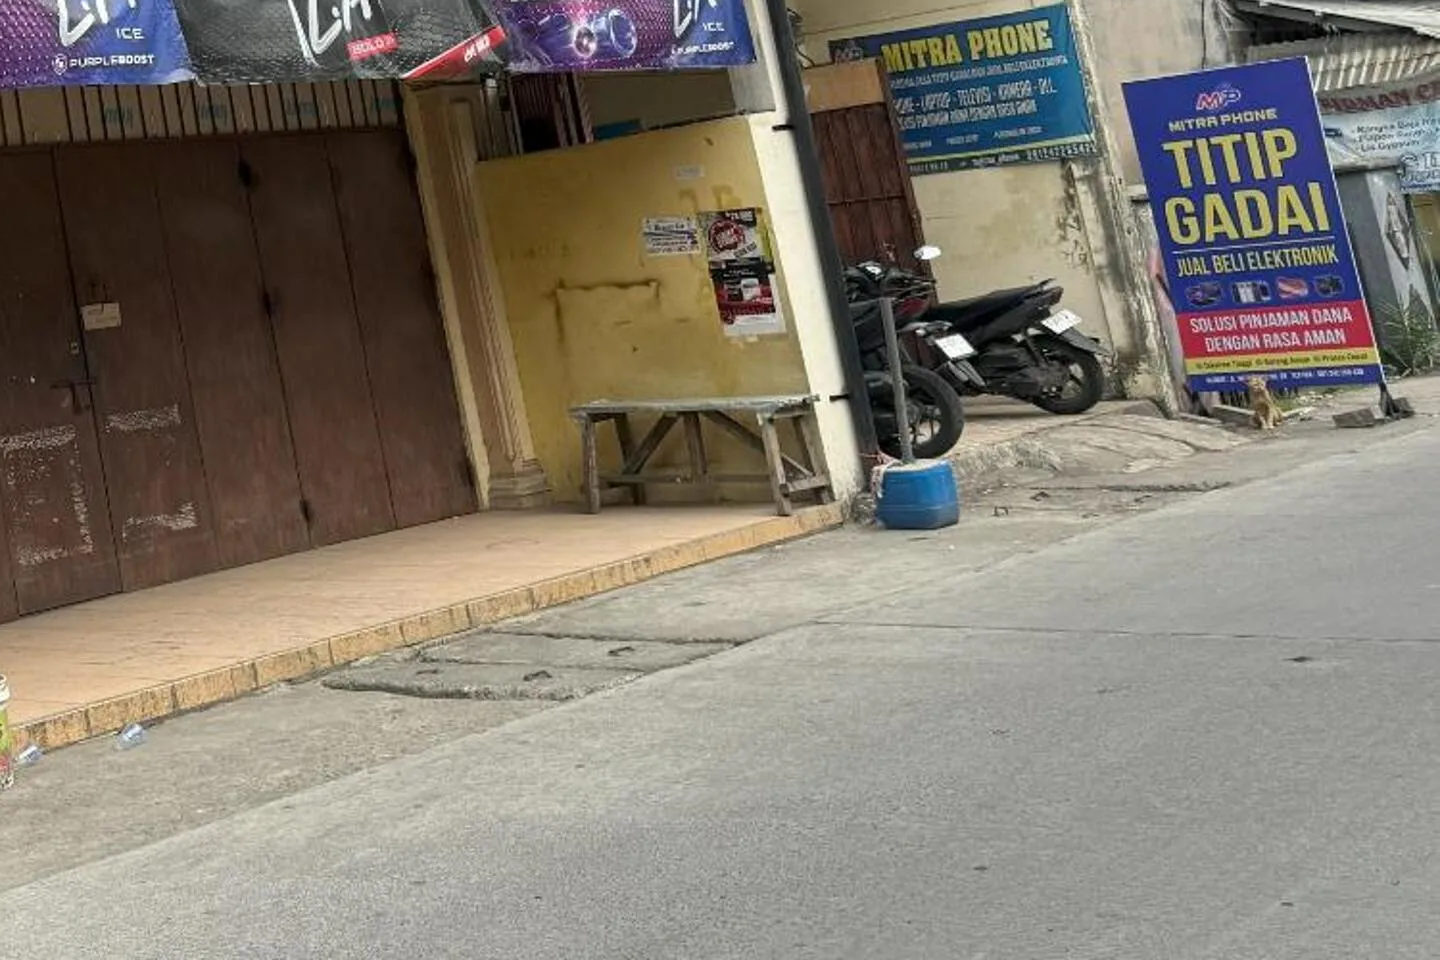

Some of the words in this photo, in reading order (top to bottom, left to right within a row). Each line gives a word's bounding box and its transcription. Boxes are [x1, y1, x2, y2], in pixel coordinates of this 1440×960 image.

[116, 28, 145, 40] ICE
[702, 22, 725, 32] ICE
[881, 34, 962, 73] MITRA
[967, 19, 1053, 61] PHONE
[1168, 115, 1219, 132] MITRA
[1220, 108, 1277, 126] PHONE
[1162, 128, 1297, 189] TITIP
[1165, 182, 1330, 245] GADAI
[1178, 256, 1211, 277] JUAL
[1213, 251, 1245, 274] BELI
[1248, 243, 1339, 271] ELEKTRONIK
[1189, 316, 1238, 333] SOLUSI
[1239, 309, 1310, 328] PINJAMAN
[1312, 306, 1353, 324] DANA
[1205, 334, 1264, 353] DENGAN
[1265, 330, 1303, 348] RASA
[1305, 327, 1346, 345] AMAN
